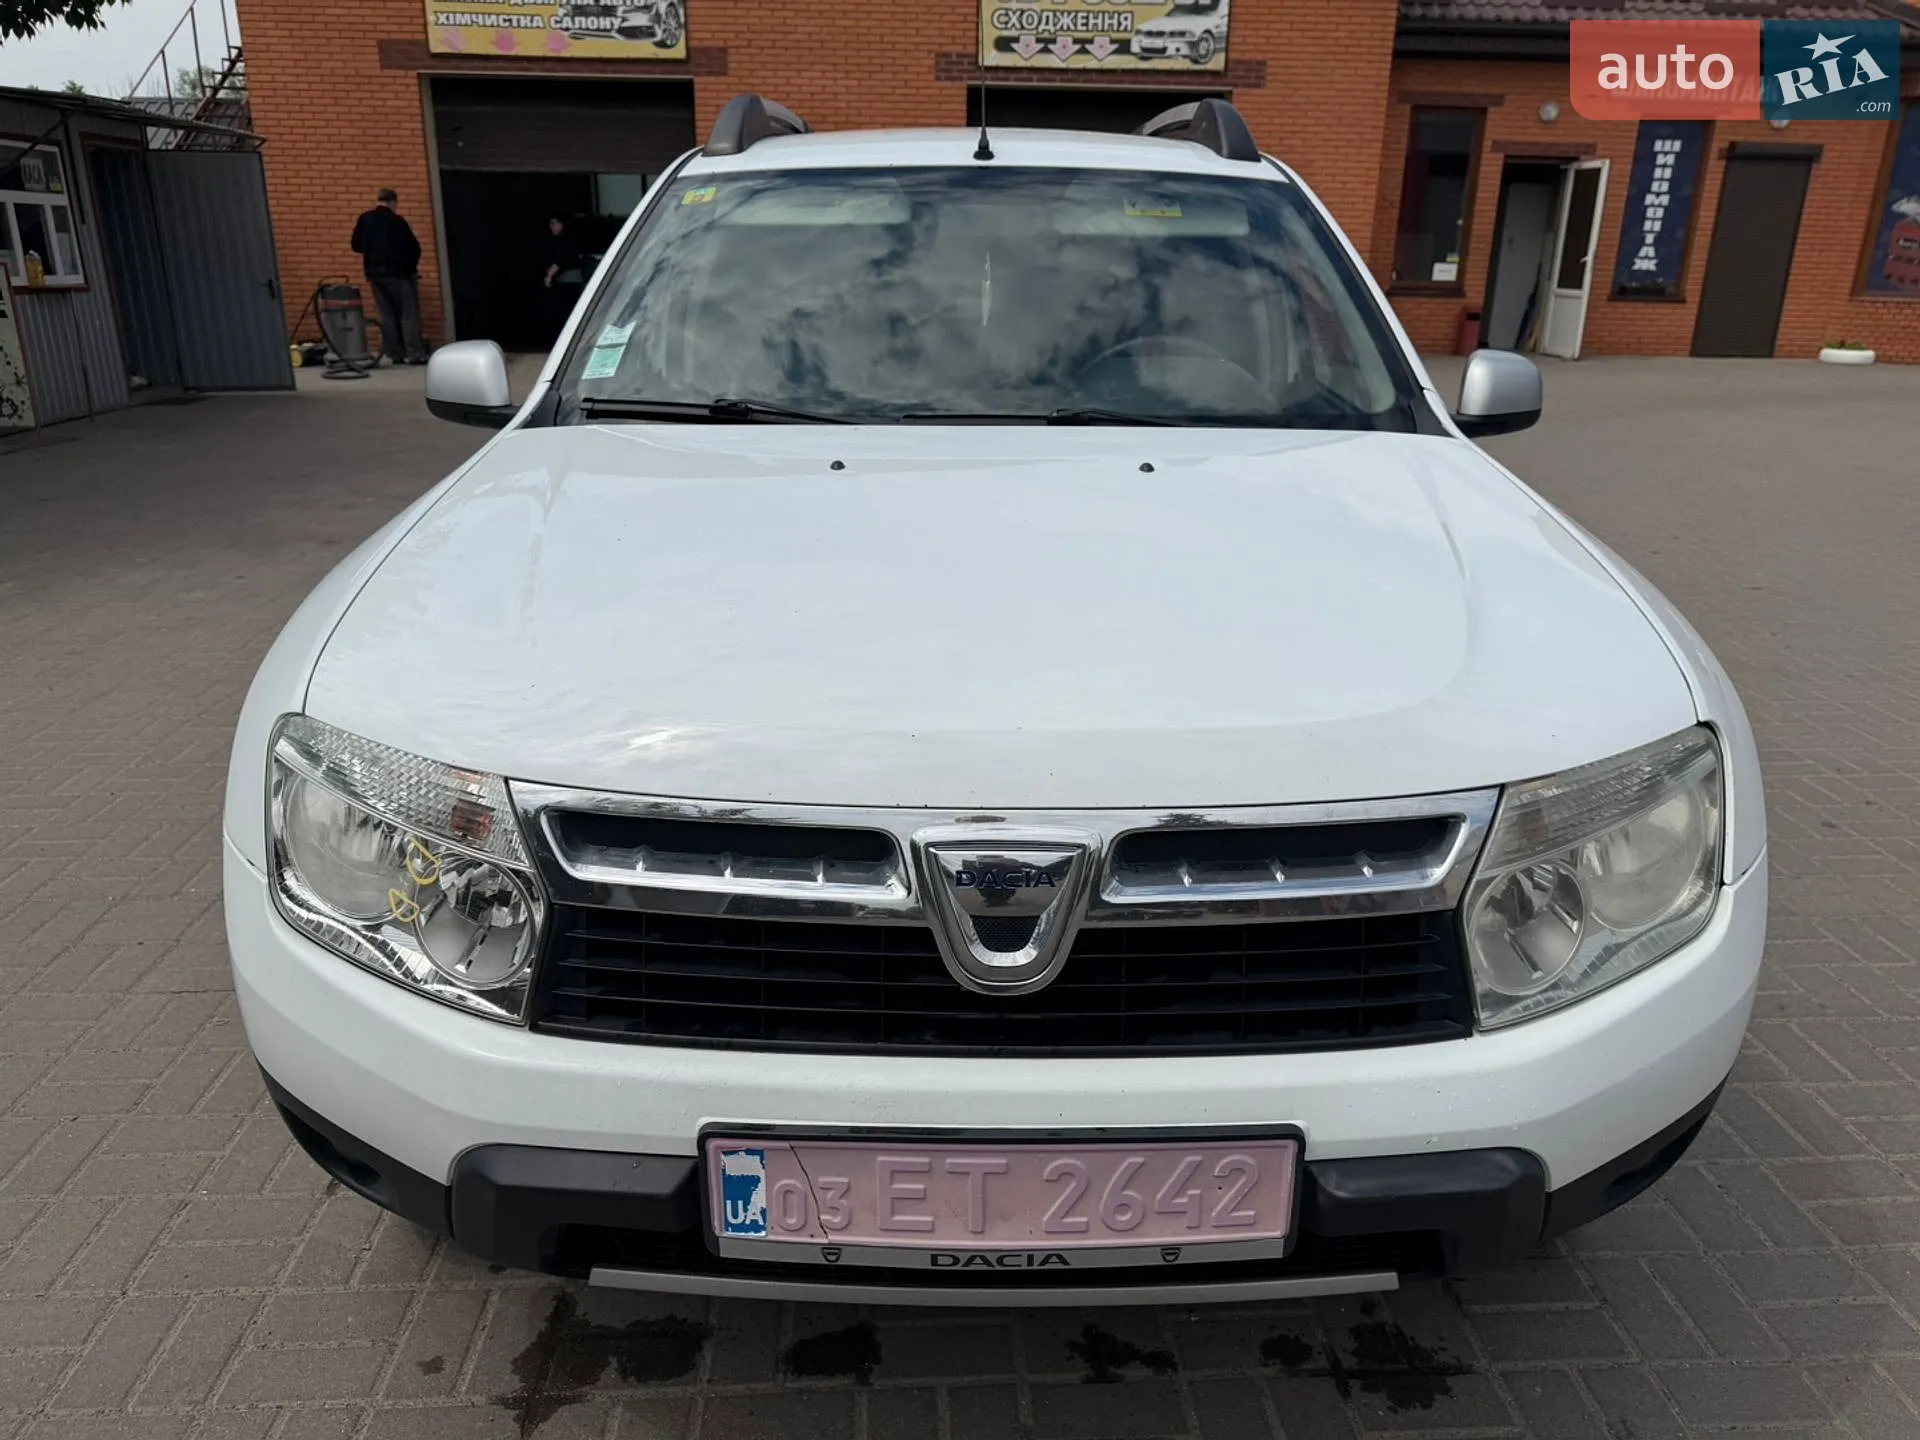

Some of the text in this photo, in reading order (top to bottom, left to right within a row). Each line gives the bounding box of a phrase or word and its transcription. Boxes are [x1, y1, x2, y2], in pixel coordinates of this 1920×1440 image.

[437, 12, 622, 30] ХІМЧИСТКА САЛОНУ
[992, 10, 1133, 34] СХОДЖЕННЯ
[1632, 139, 1682, 271] ШИНОМОНТАЖ
[955, 870, 1056, 888] DACIA
[772, 1154, 1258, 1234] 03 ET 2642
[726, 1200, 764, 1225] UA
[930, 1253, 1071, 1268] DACIA
